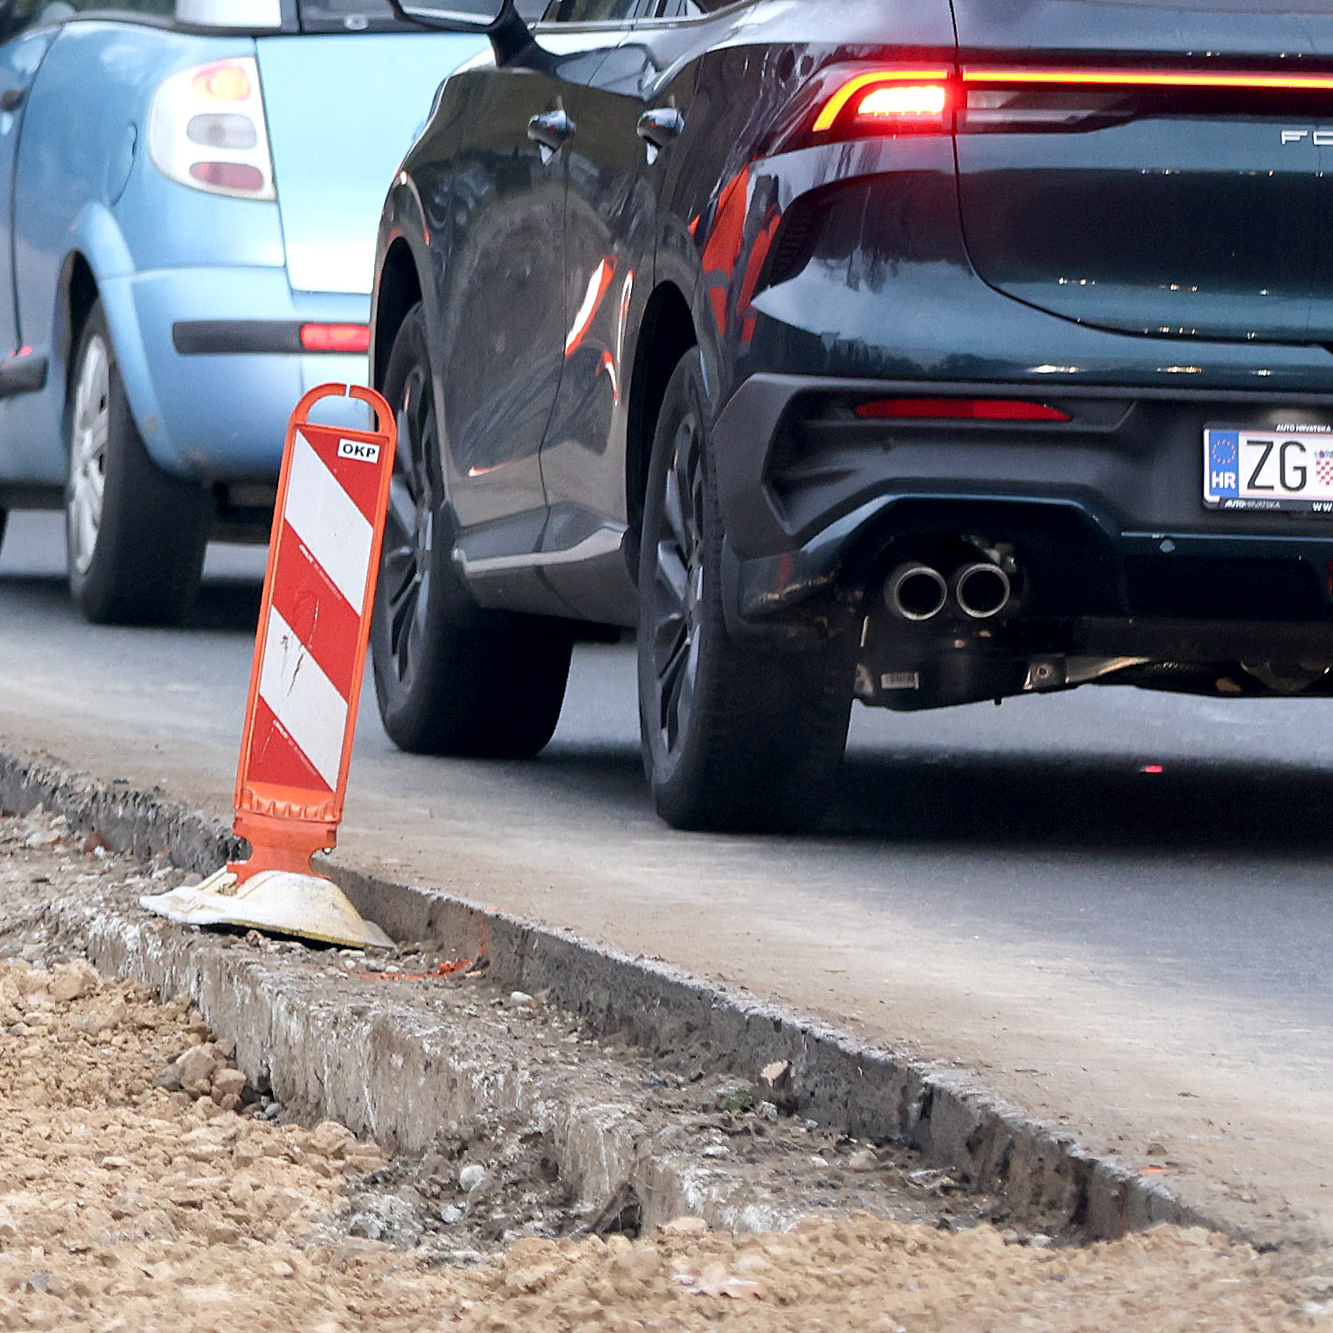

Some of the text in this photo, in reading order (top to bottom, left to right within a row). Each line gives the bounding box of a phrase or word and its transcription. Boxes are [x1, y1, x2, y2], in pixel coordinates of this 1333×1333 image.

[343, 443, 376, 457] OKP
[1246, 439, 1307, 492] ZG
[1212, 471, 1236, 489] HR
